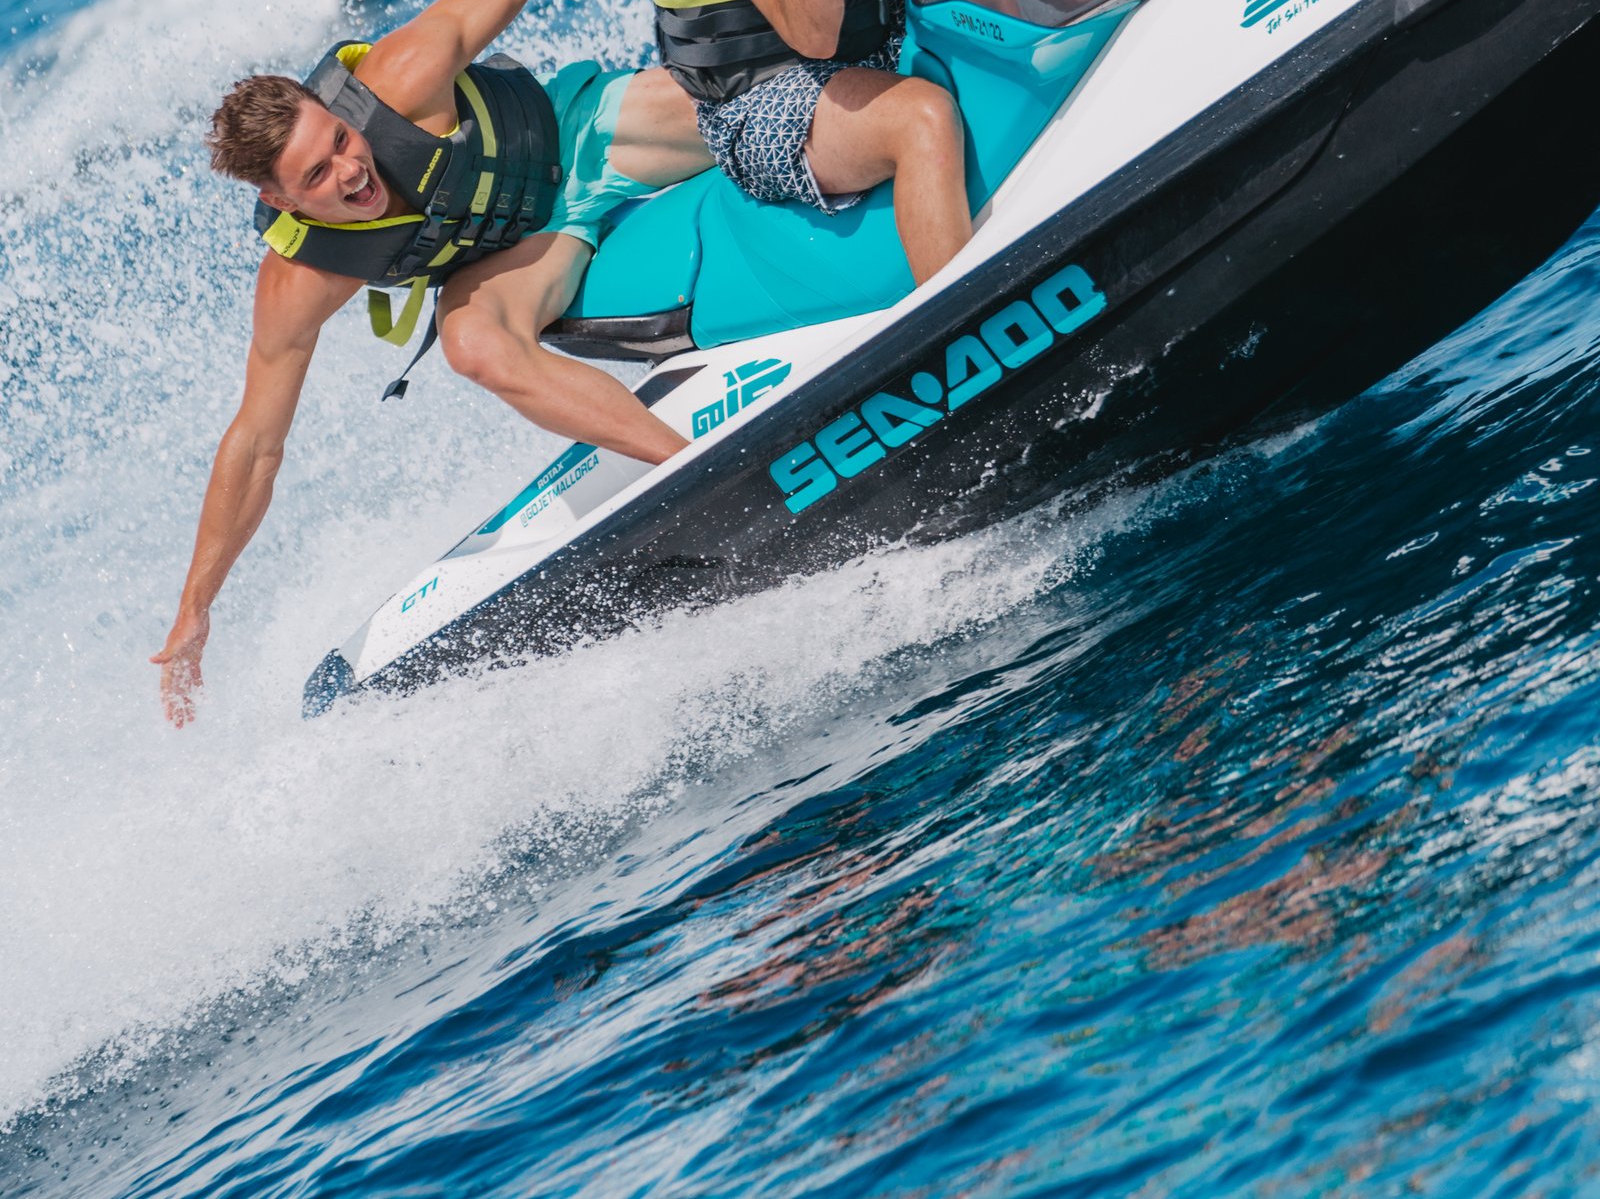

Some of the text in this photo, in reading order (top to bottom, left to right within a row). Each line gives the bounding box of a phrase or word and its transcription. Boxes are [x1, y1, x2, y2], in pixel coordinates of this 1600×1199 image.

[1265, 14, 1282, 34] Jet
[1285, 3, 1303, 22] Ski
[519, 453, 600, 528] @GOJETMALLORCA
[536, 461, 565, 490] ROTAX
[401, 576, 438, 613] GTI
